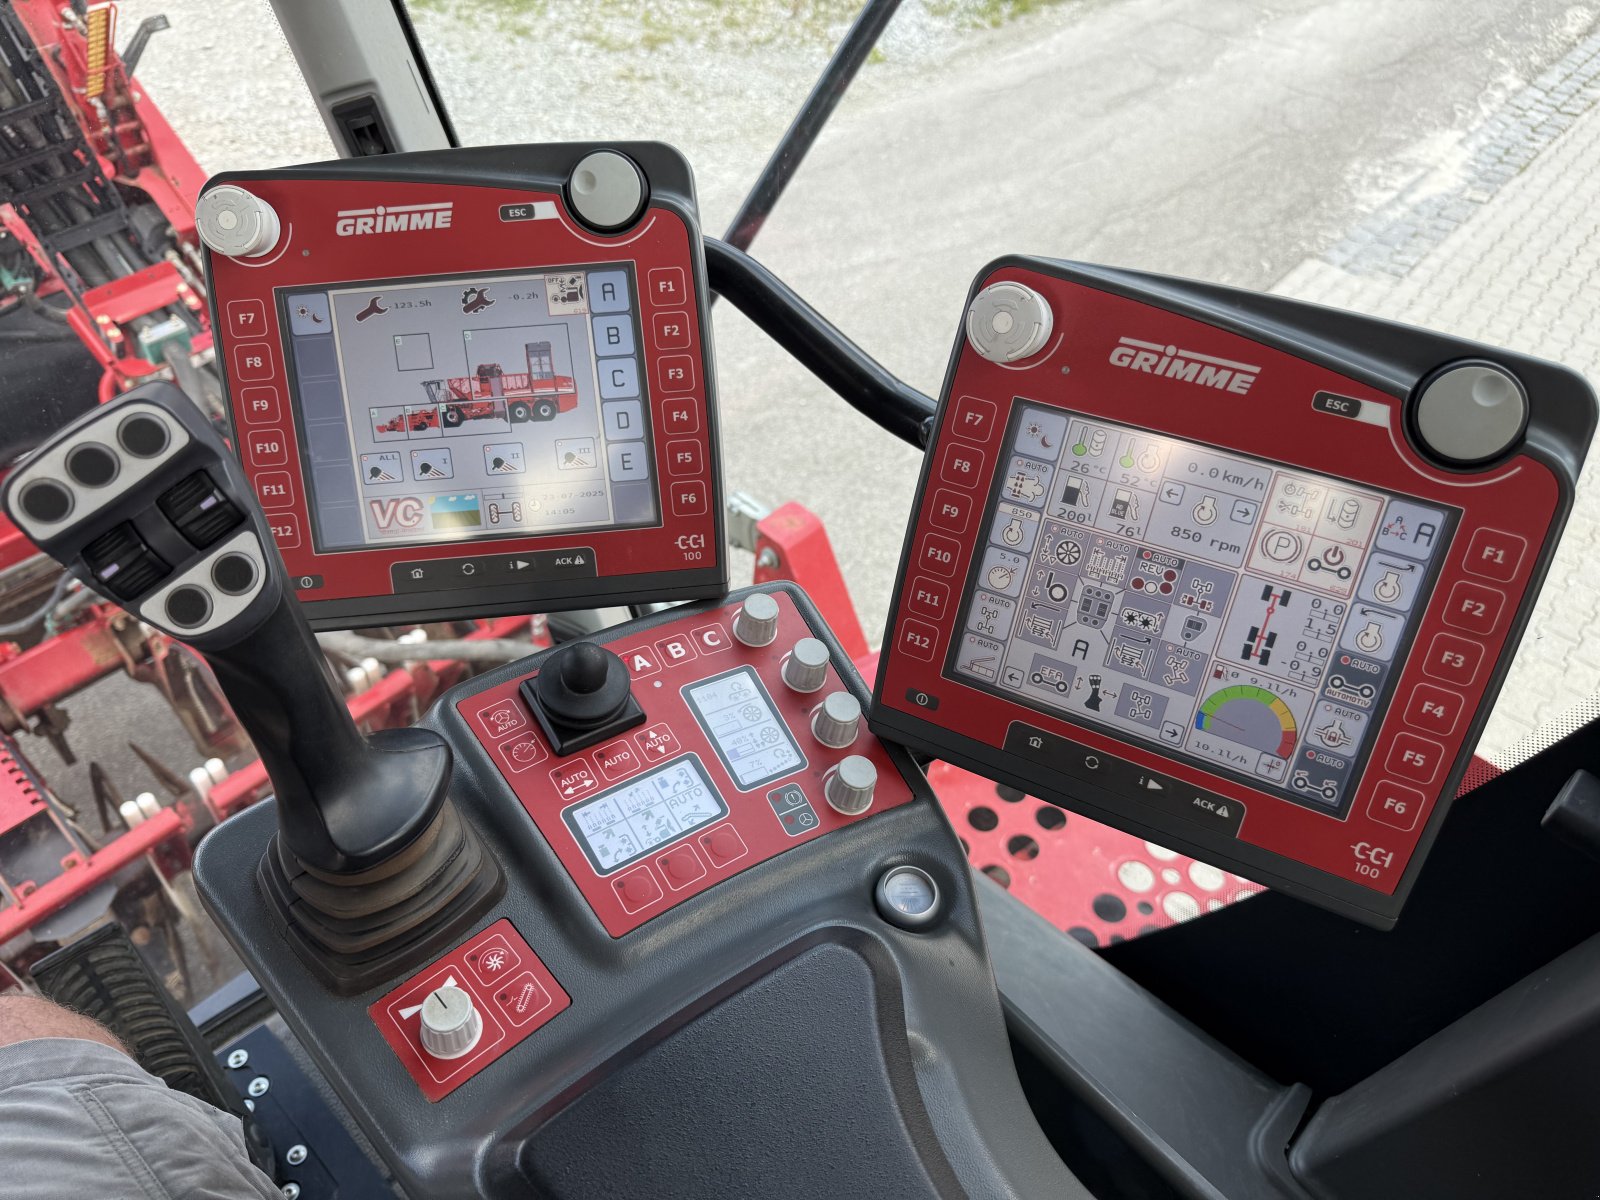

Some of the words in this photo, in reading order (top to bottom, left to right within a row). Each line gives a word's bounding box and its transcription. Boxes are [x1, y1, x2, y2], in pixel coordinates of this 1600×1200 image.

[508, 208, 527, 217] ESC
[336, 205, 453, 236] GRIMME
[601, 282, 616, 301] A
[659, 281, 675, 292] F1
[238, 312, 255, 325] F7
[606, 326, 620, 345] B
[663, 325, 680, 336] F2
[245, 356, 262, 369] F8
[668, 368, 684, 379] F3
[1108, 345, 1256, 395] GRIMME
[611, 369, 625, 387] C
[252, 399, 269, 412] F9
[1324, 398, 1350, 412] ESC
[616, 411, 630, 429] D
[672, 410, 688, 422] F4
[964, 412, 983, 426] F7
[256, 442, 279, 454] F10
[621, 453, 633, 470] E
[677, 452, 692, 463] F5
[953, 459, 971, 473] F8
[1025, 462, 1048, 472] AUTO
[1070, 460, 1089, 474] 26
[1120, 473, 1140, 487] 52
[1188, 462, 1219, 478] 0.0
[1222, 470, 1264, 490] km/h
[262, 484, 286, 497] F11
[681, 493, 697, 504] F6
[545, 507, 575, 516] 14:05
[942, 504, 959, 518] F9
[1011, 507, 1032, 519] 850
[1395, 516, 1403, 525] A
[270, 525, 293, 537] F12
[1060, 527, 1084, 539] AUTO
[1381, 527, 1389, 535] B
[1399, 532, 1407, 540] C
[1413, 522, 1436, 547] A
[1106, 540, 1130, 552] AUTO
[1170, 526, 1202, 542] 850
[1209, 538, 1241, 554] rpm
[555, 557, 572, 566] ACK
[683, 551, 702, 561] 100
[927, 547, 952, 563] F10
[1000, 552, 1020, 563] 5.0
[1152, 553, 1178, 566] AUTO
[1481, 546, 1505, 564] F1
[1140, 562, 1164, 575] REV
[916, 590, 940, 607] F11
[988, 596, 1010, 608] AUTO
[1311, 598, 1344, 616] 0.0
[1461, 600, 1486, 617] F2
[1305, 617, 1337, 635] 1.5
[702, 630, 721, 646] C
[906, 632, 931, 648] F12
[977, 639, 999, 651] AUTO
[666, 642, 686, 659] B
[1071, 638, 1090, 661] A
[1175, 647, 1201, 660] AUTO
[1296, 640, 1329, 658] 0.0
[633, 654, 652, 672] A
[1350, 659, 1379, 673] AUTO
[1441, 651, 1466, 669] F3
[1040, 666, 1063, 680] EFA
[1335, 708, 1361, 721] AUTO
[1421, 700, 1445, 718] F4
[498, 719, 518, 733] AUTO
[645, 734, 671, 750] AUTO
[604, 752, 630, 769] AUTO
[1316, 754, 1344, 769] AUTO
[1402, 750, 1426, 767] F5
[561, 770, 588, 787] AUTO
[669, 787, 703, 809] AUTO
[1192, 797, 1215, 811] ACK
[1383, 797, 1406, 815] F6
[1355, 861, 1380, 879] 100
